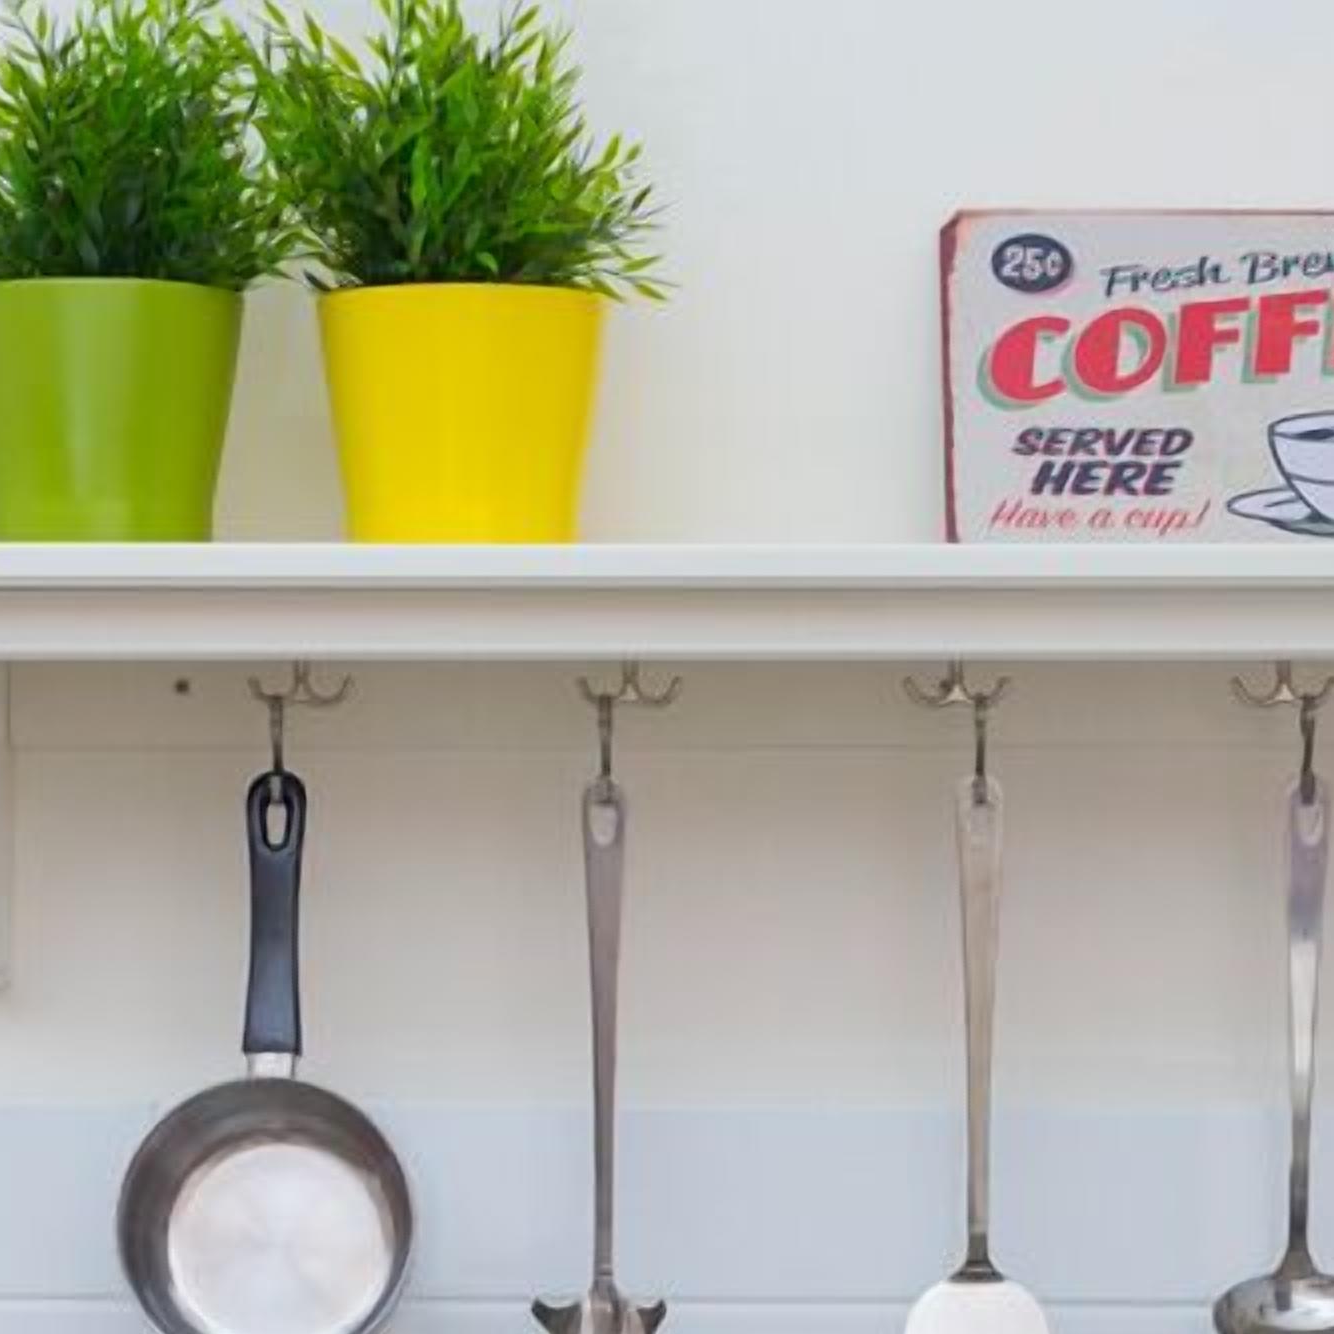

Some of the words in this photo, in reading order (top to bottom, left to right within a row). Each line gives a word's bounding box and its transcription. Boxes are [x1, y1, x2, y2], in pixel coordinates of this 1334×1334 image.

[1099, 255, 1229, 297] Fresh
[1009, 426, 1195, 457] SERVED
[1030, 459, 1185, 496] HERE
[987, 498, 1077, 531] Have
[1087, 507, 1113, 529] a
[1123, 497, 1211, 537] cup!
